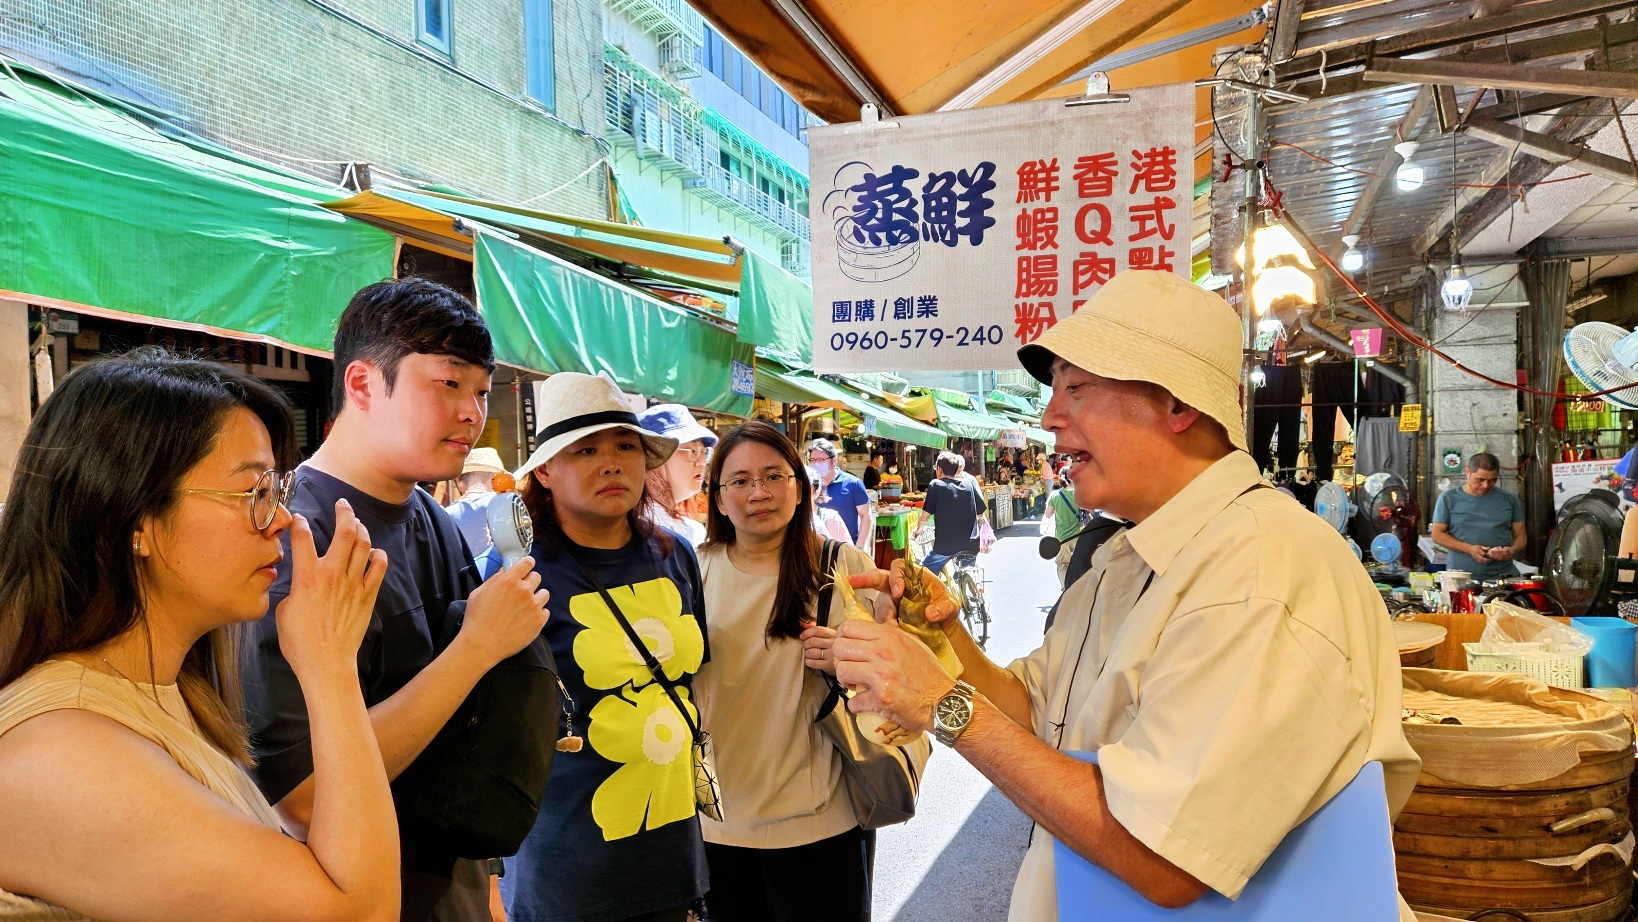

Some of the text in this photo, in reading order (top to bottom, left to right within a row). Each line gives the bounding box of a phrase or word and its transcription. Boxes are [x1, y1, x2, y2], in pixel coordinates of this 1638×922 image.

[1014, 157, 1061, 345] 鮮蝦腸粉
[1072, 152, 1120, 314] 香Q肉
[830, 324, 1004, 351] 0960-579-240
[831, 299, 875, 323] 團購
[893, 295, 939, 320] 創業
